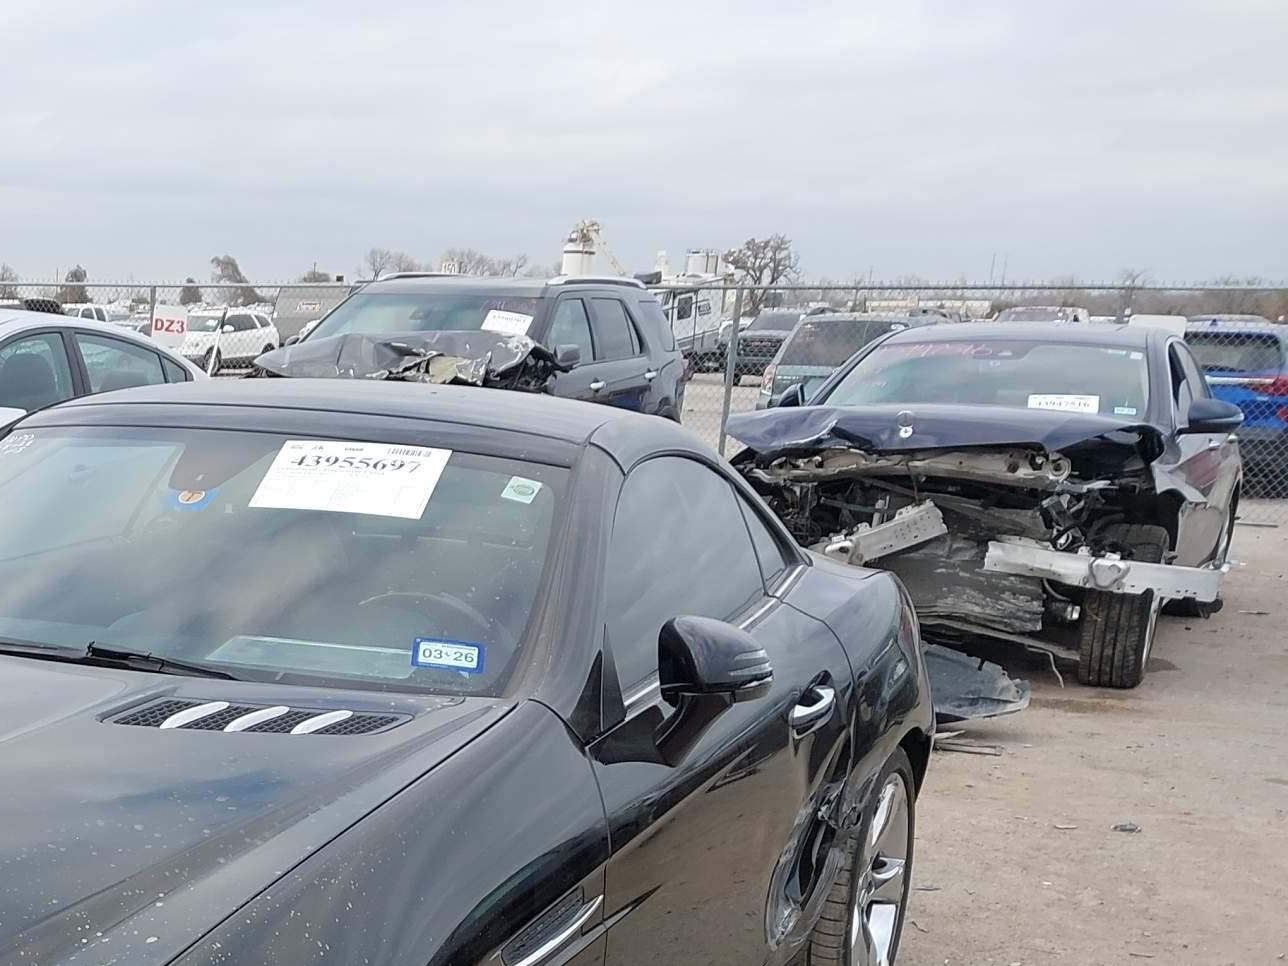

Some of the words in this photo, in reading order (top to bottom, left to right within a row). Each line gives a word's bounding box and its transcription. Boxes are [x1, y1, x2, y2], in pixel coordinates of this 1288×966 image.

[154, 318, 185, 334] DZ3
[290, 454, 422, 474] 43955697
[422, 648, 443, 660] 03
[453, 651, 475, 663] 26
